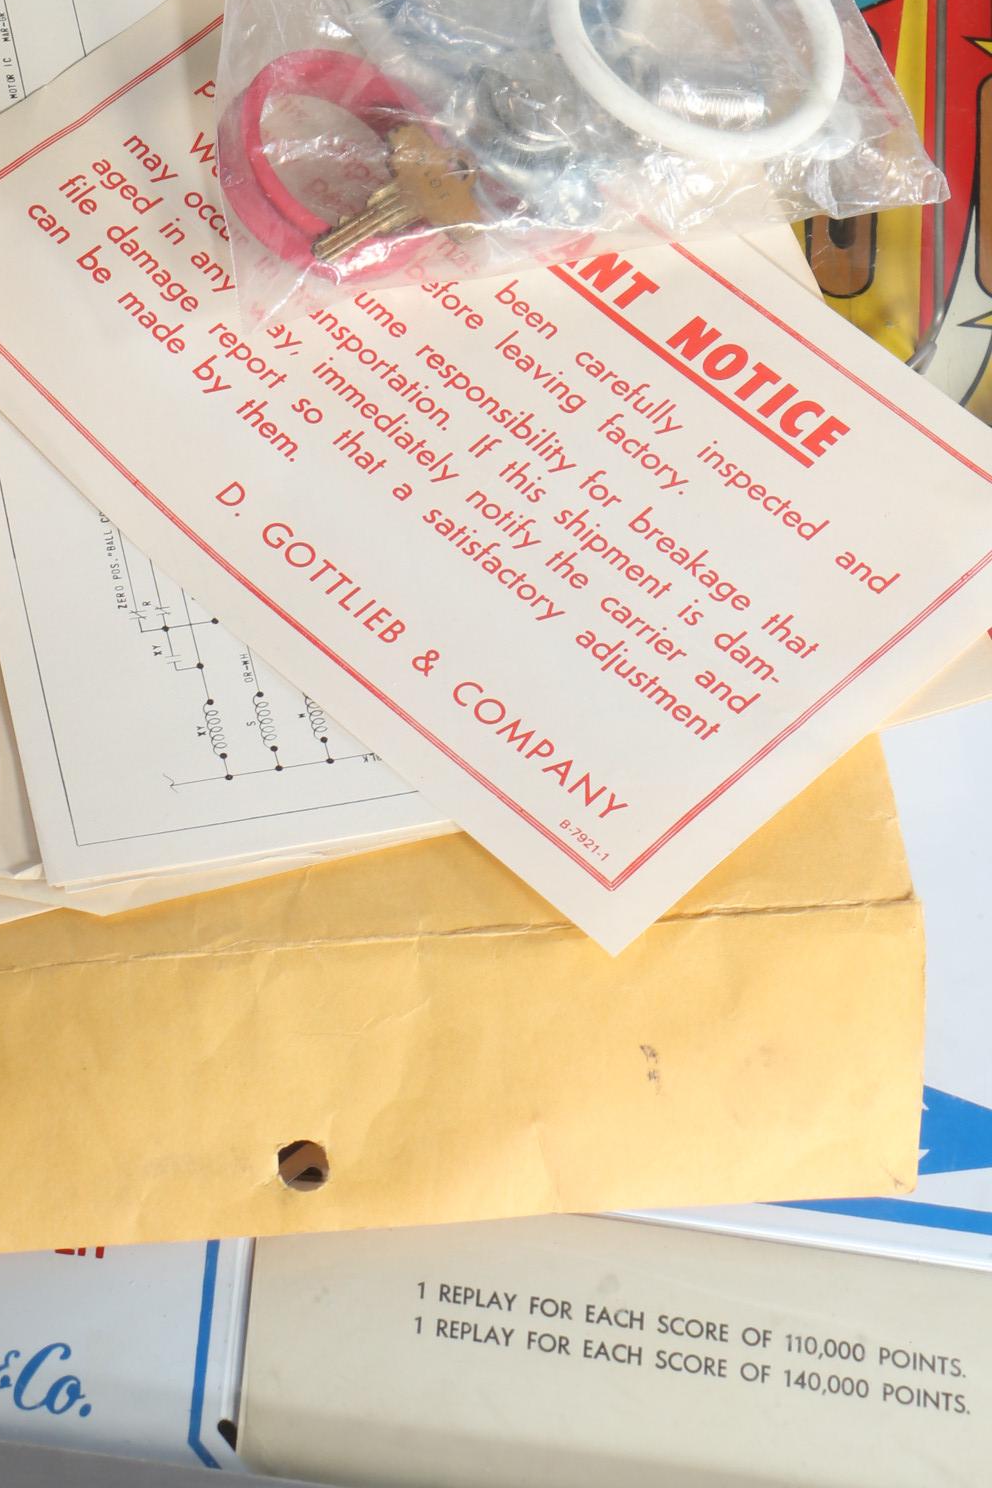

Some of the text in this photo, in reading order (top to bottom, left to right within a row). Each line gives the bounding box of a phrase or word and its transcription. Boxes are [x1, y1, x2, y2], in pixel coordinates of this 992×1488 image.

[7, 73, 19, 100] MOTOR
[59, 173, 720, 741] file damage report so that a satisfactory adjustment
[415, 343, 819, 658] responsibility for breakage that
[494, 278, 558, 340] been
[574, 351, 682, 435] carefully
[697, 445, 830, 541] inspected
[834, 551, 901, 594] and
[666, 315, 852, 461] NOTICE
[214, 480, 628, 817] D. GOTTLIEB & COMPANY
[559, 818, 609, 861] B-7921-1
[417, 1281, 966, 1378] 1 REPLAY FOR EACH SCORE OF 110,000 POINTS.
